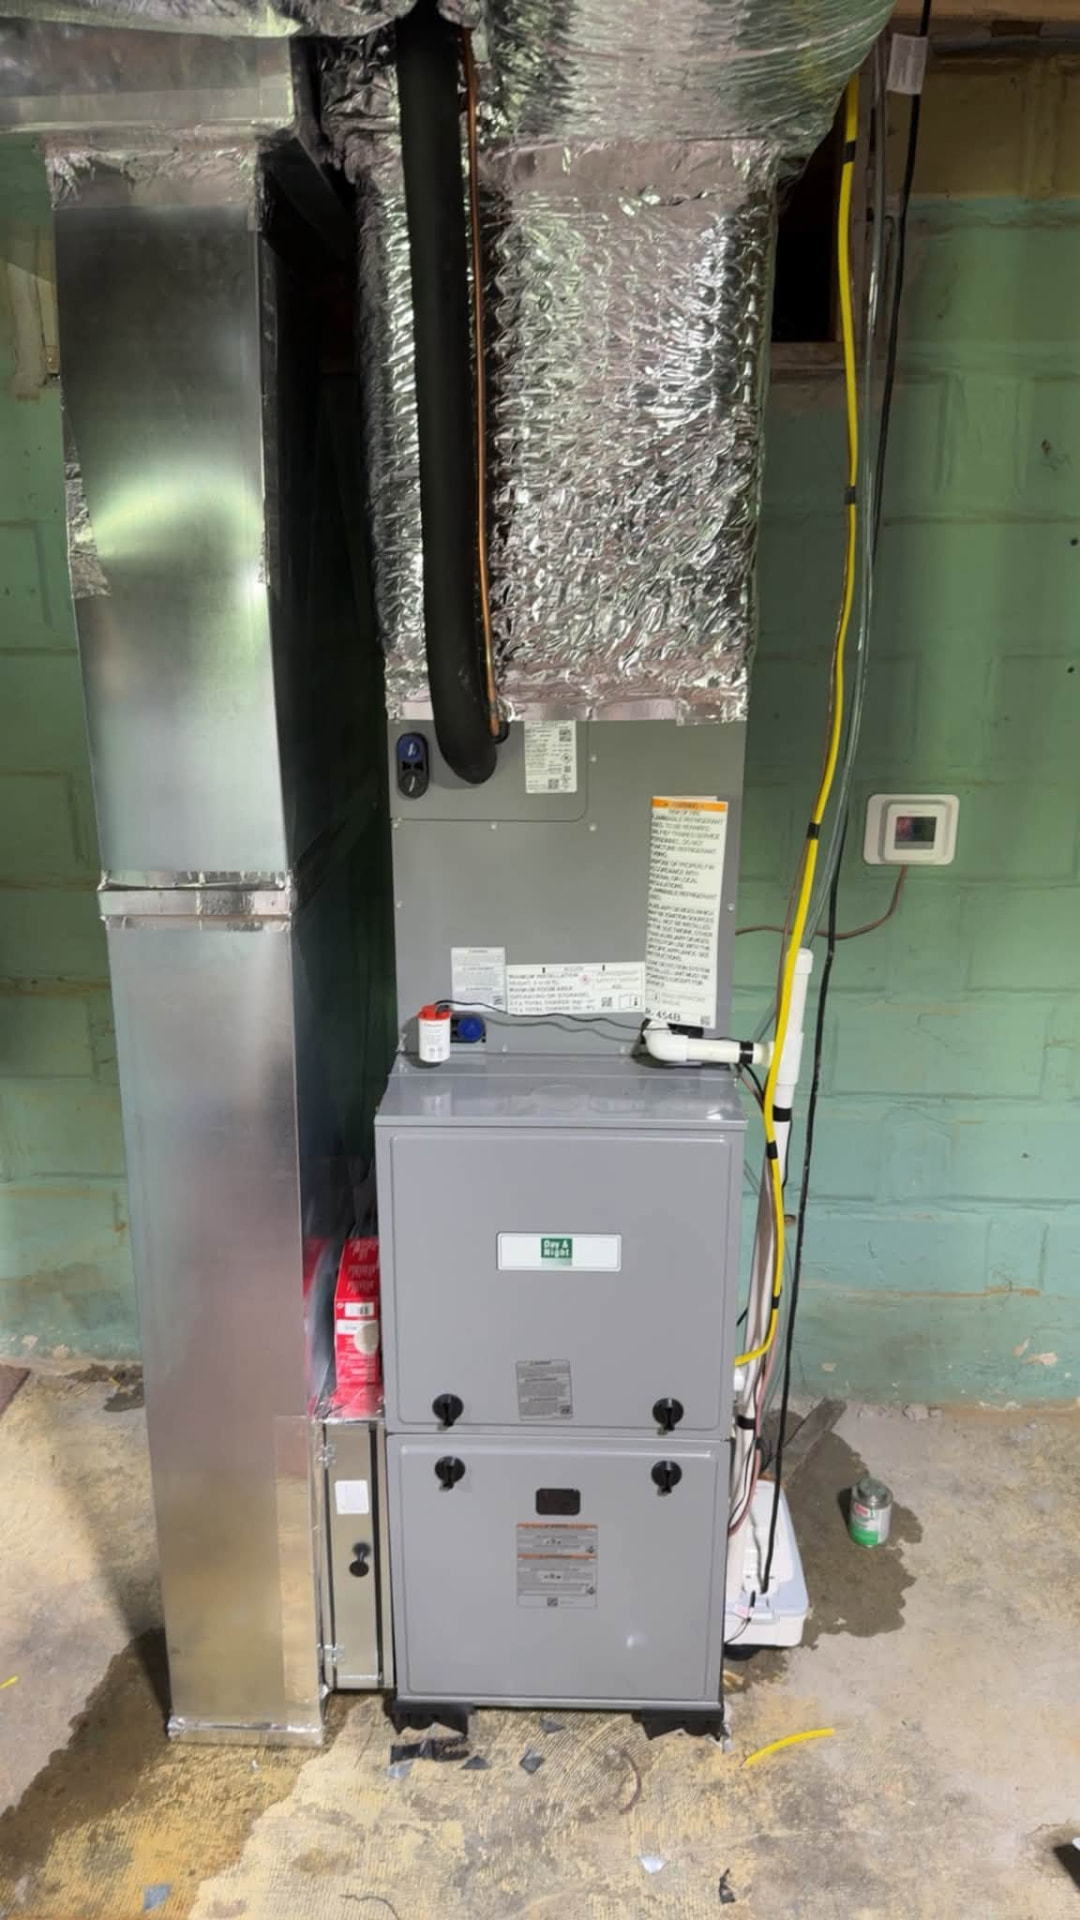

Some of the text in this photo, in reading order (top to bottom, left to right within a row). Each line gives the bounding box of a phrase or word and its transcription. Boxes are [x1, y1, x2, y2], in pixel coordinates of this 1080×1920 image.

[544, 1240, 568, 1250] Day &
[544, 1249, 570, 1258] Night
